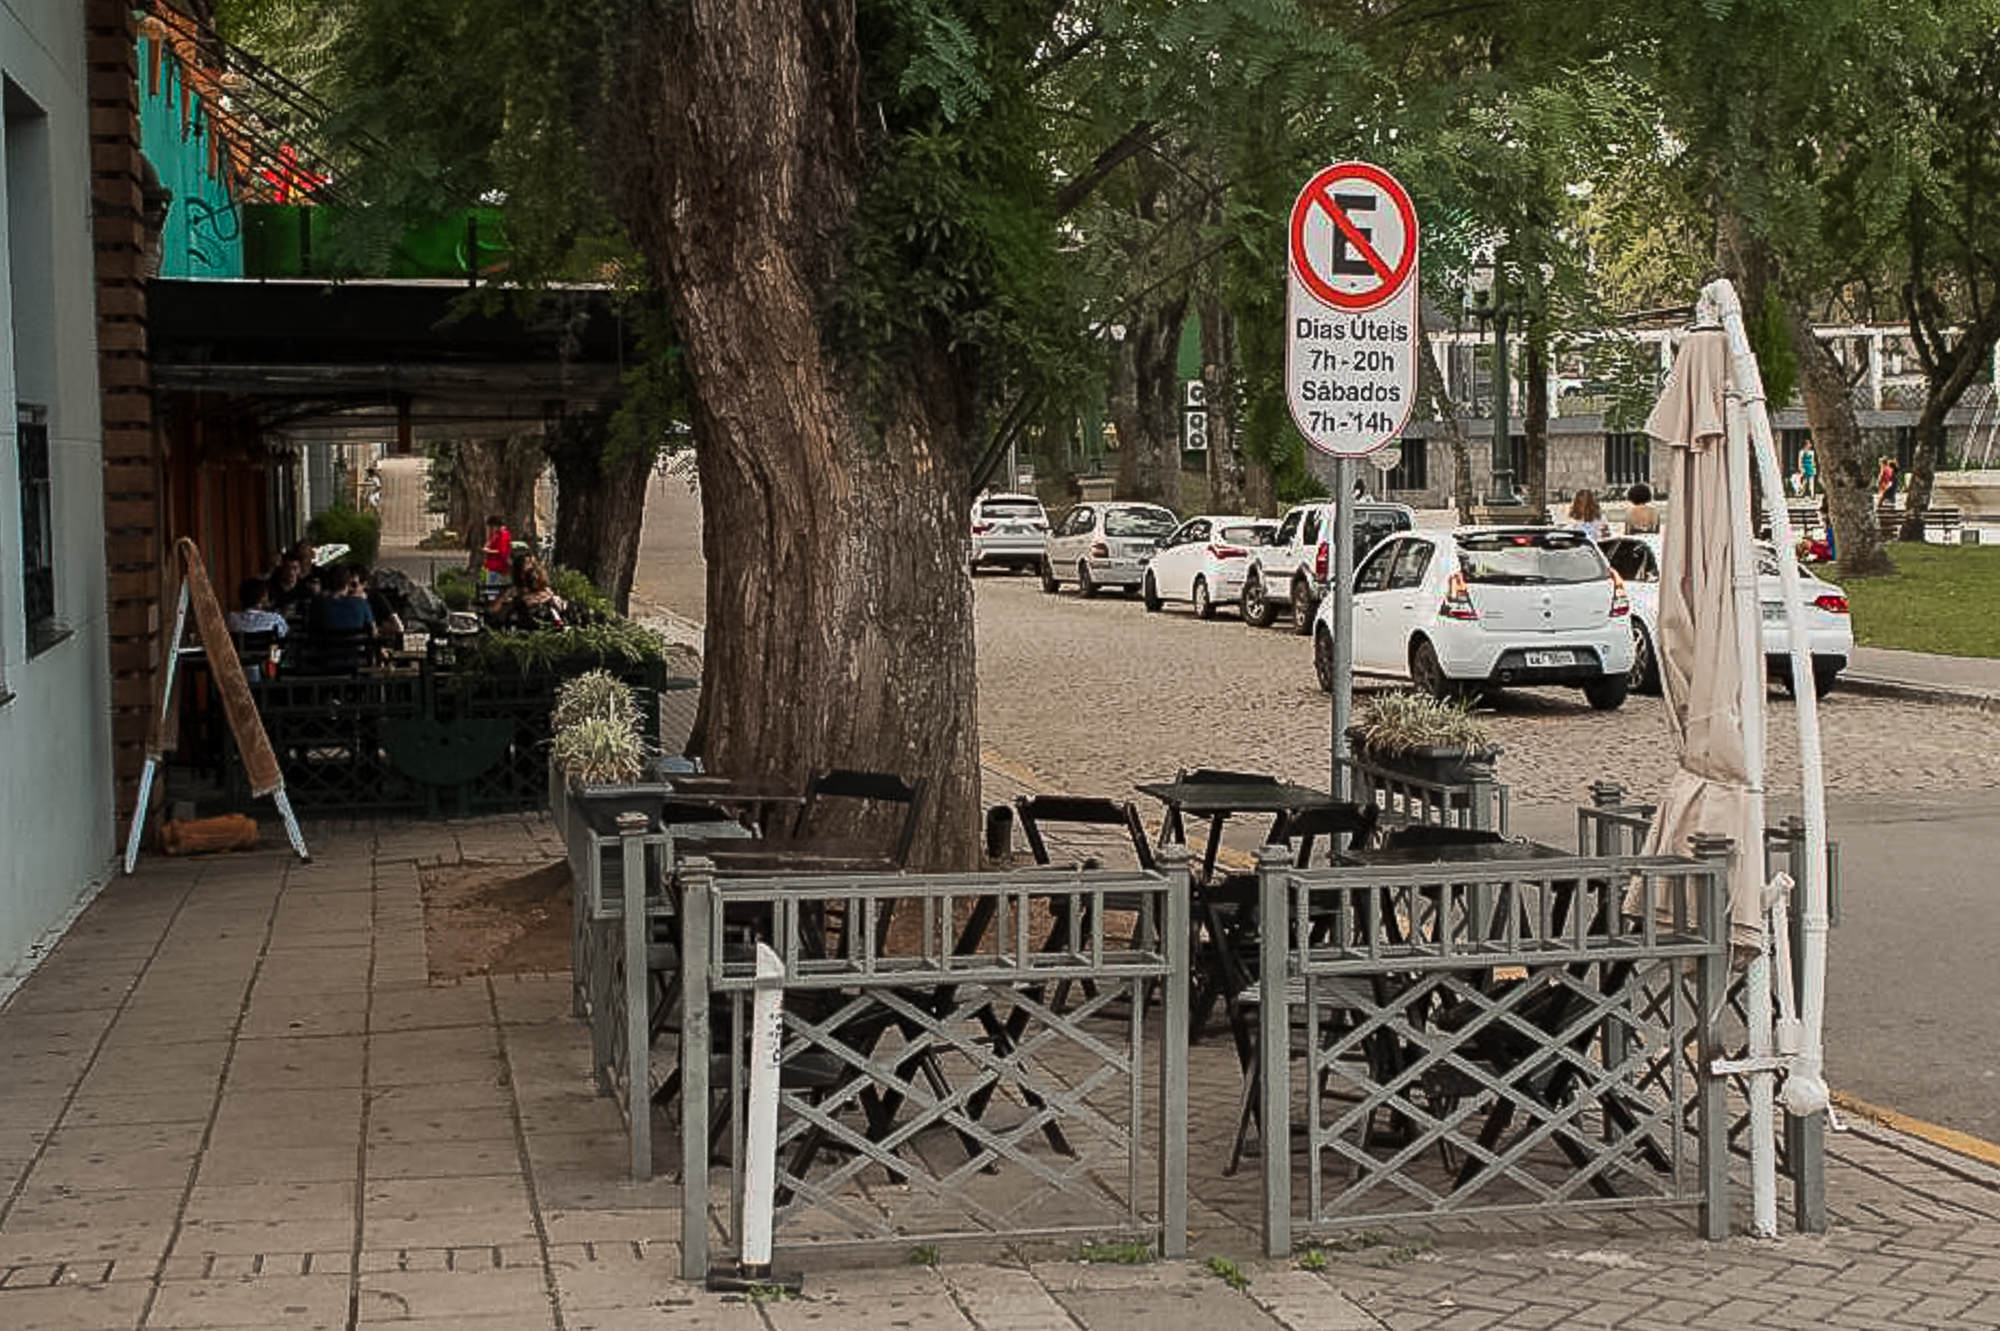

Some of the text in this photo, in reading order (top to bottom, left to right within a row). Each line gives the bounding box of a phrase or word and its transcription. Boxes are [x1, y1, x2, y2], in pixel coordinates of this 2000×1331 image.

[1332, 193, 1377, 276] E
[1297, 314, 1408, 341] Dias Úteis
[1302, 380, 1401, 402] Sábados
